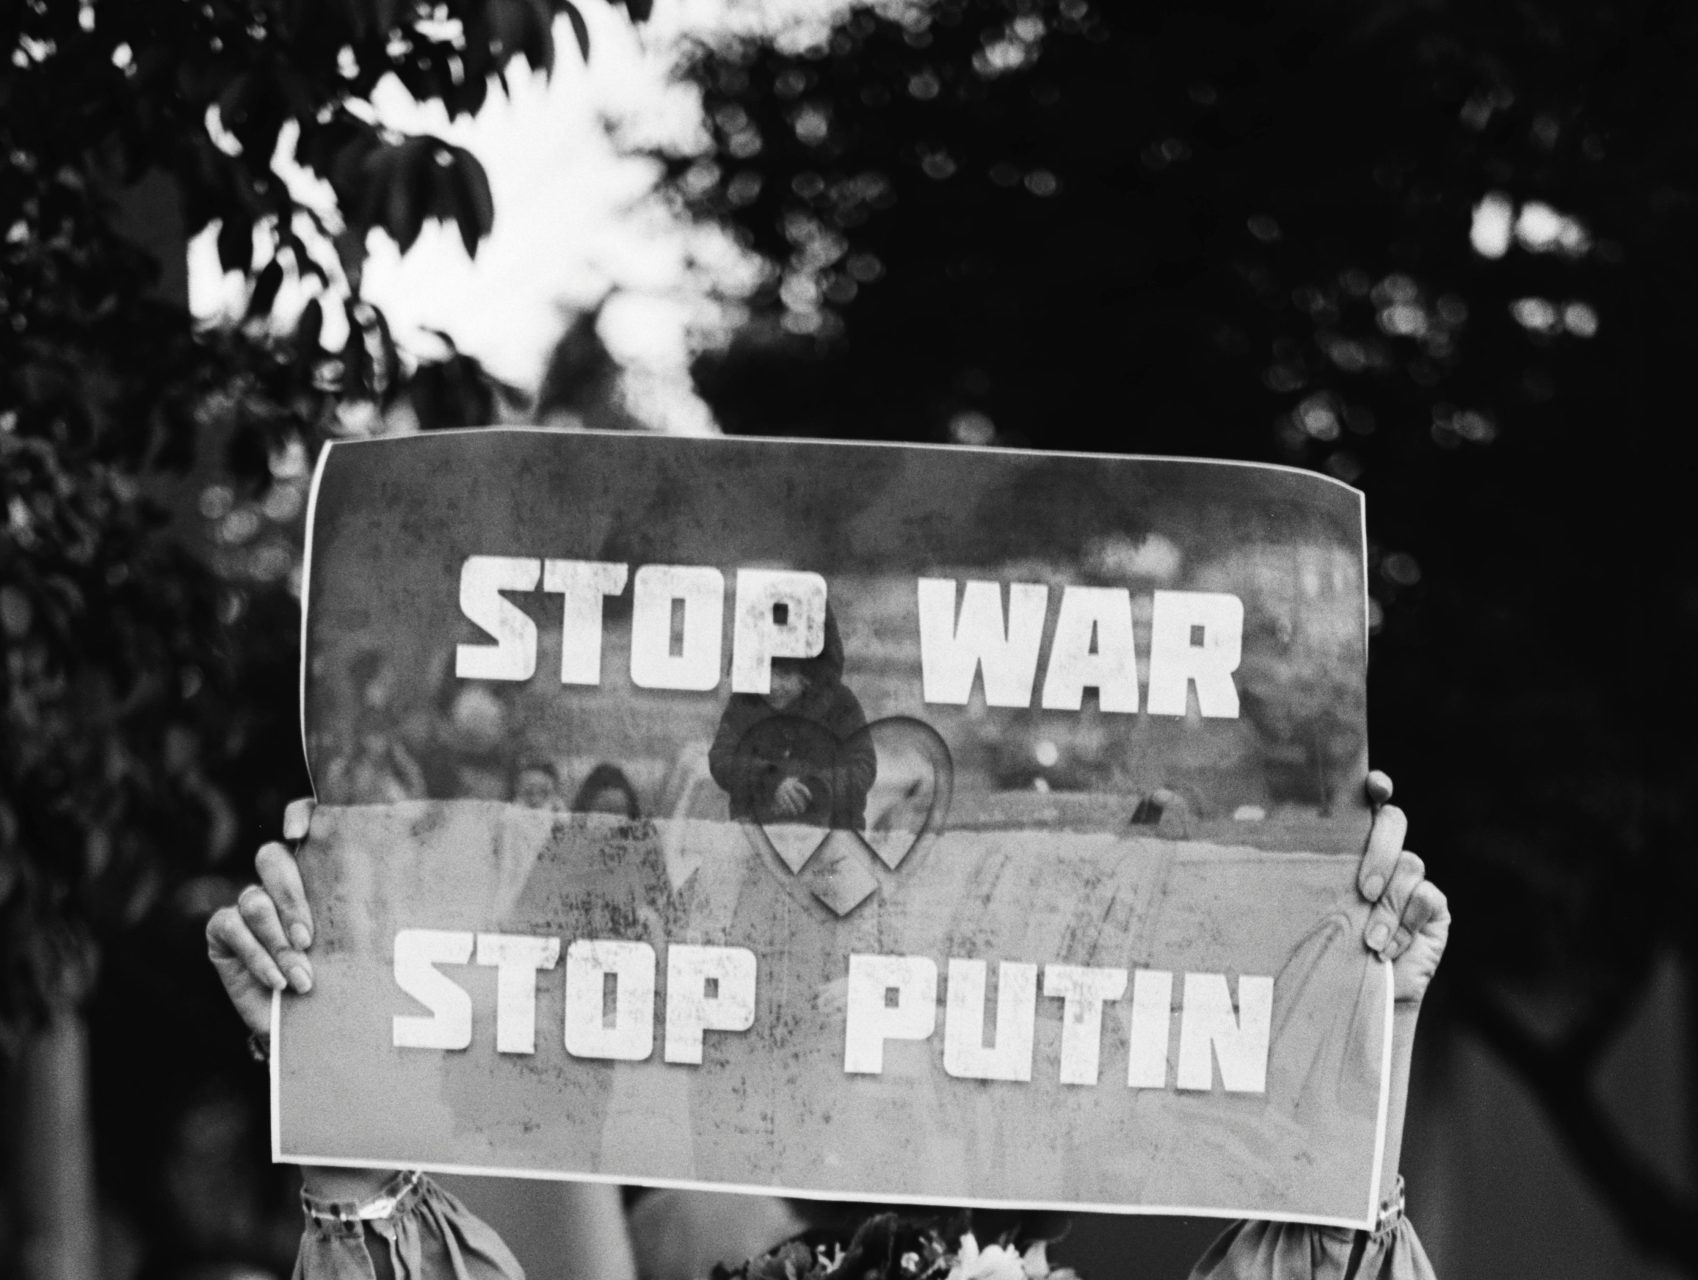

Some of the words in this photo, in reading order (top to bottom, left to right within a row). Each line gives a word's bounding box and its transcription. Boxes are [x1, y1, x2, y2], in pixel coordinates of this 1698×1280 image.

[456, 554, 828, 695] STOP
[917, 576, 1245, 718] WAR
[393, 929, 757, 1065] STOP
[844, 953, 1274, 1094] PUTIN
